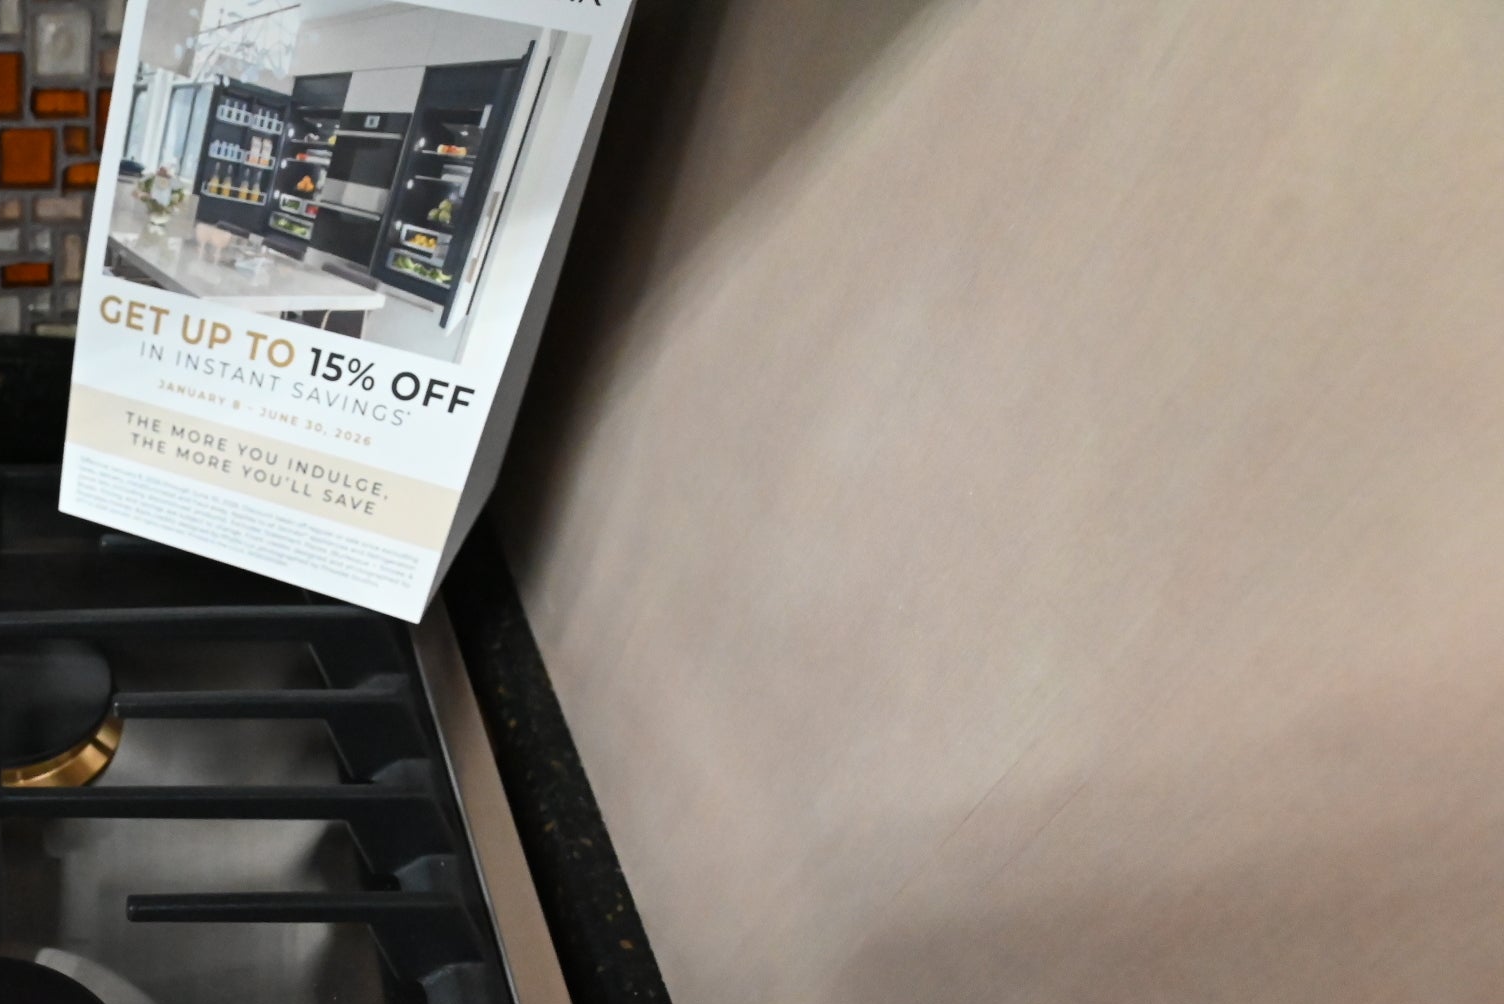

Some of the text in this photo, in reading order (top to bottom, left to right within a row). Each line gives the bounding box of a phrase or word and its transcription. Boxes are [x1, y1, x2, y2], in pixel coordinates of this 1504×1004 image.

[99, 295, 476, 414] GET UP TO 15% OFF
[139, 341, 164, 362] IN
[175, 350, 282, 392] INSTANT
[157, 379, 225, 406] JANUARY
[259, 407, 297, 427] JUNE
[334, 428, 372, 447] 2026
[125, 410, 390, 501] THE MORE YOU INDULGE,
[131, 432, 378, 516] THE MORE YOU'LL SAVE
